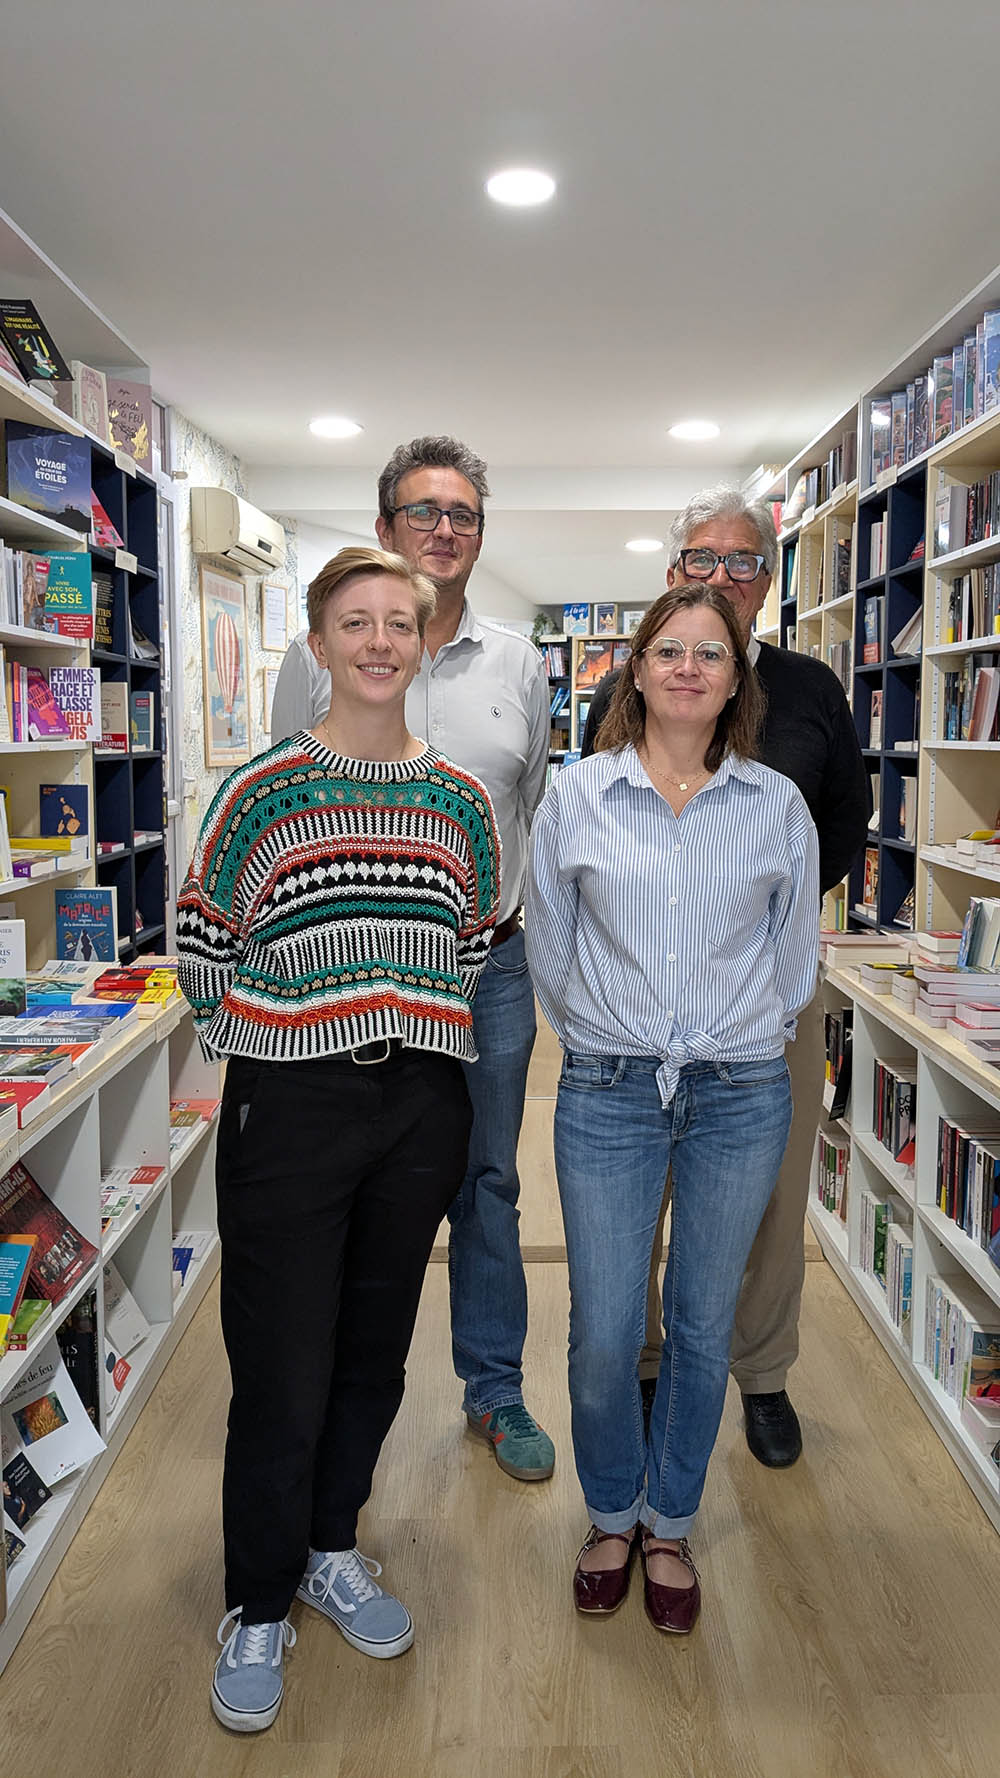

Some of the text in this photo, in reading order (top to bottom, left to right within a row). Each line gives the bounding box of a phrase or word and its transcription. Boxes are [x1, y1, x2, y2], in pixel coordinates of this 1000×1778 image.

[35, 457, 67, 471] VOYAGE
[35, 469, 67, 484] ÉTOILES
[45, 592, 83, 604] PASSÉ
[50, 668, 96, 684] FEMMES,
[51, 683, 94, 697] RACE ET
[58, 902, 110, 921] MATRICE
